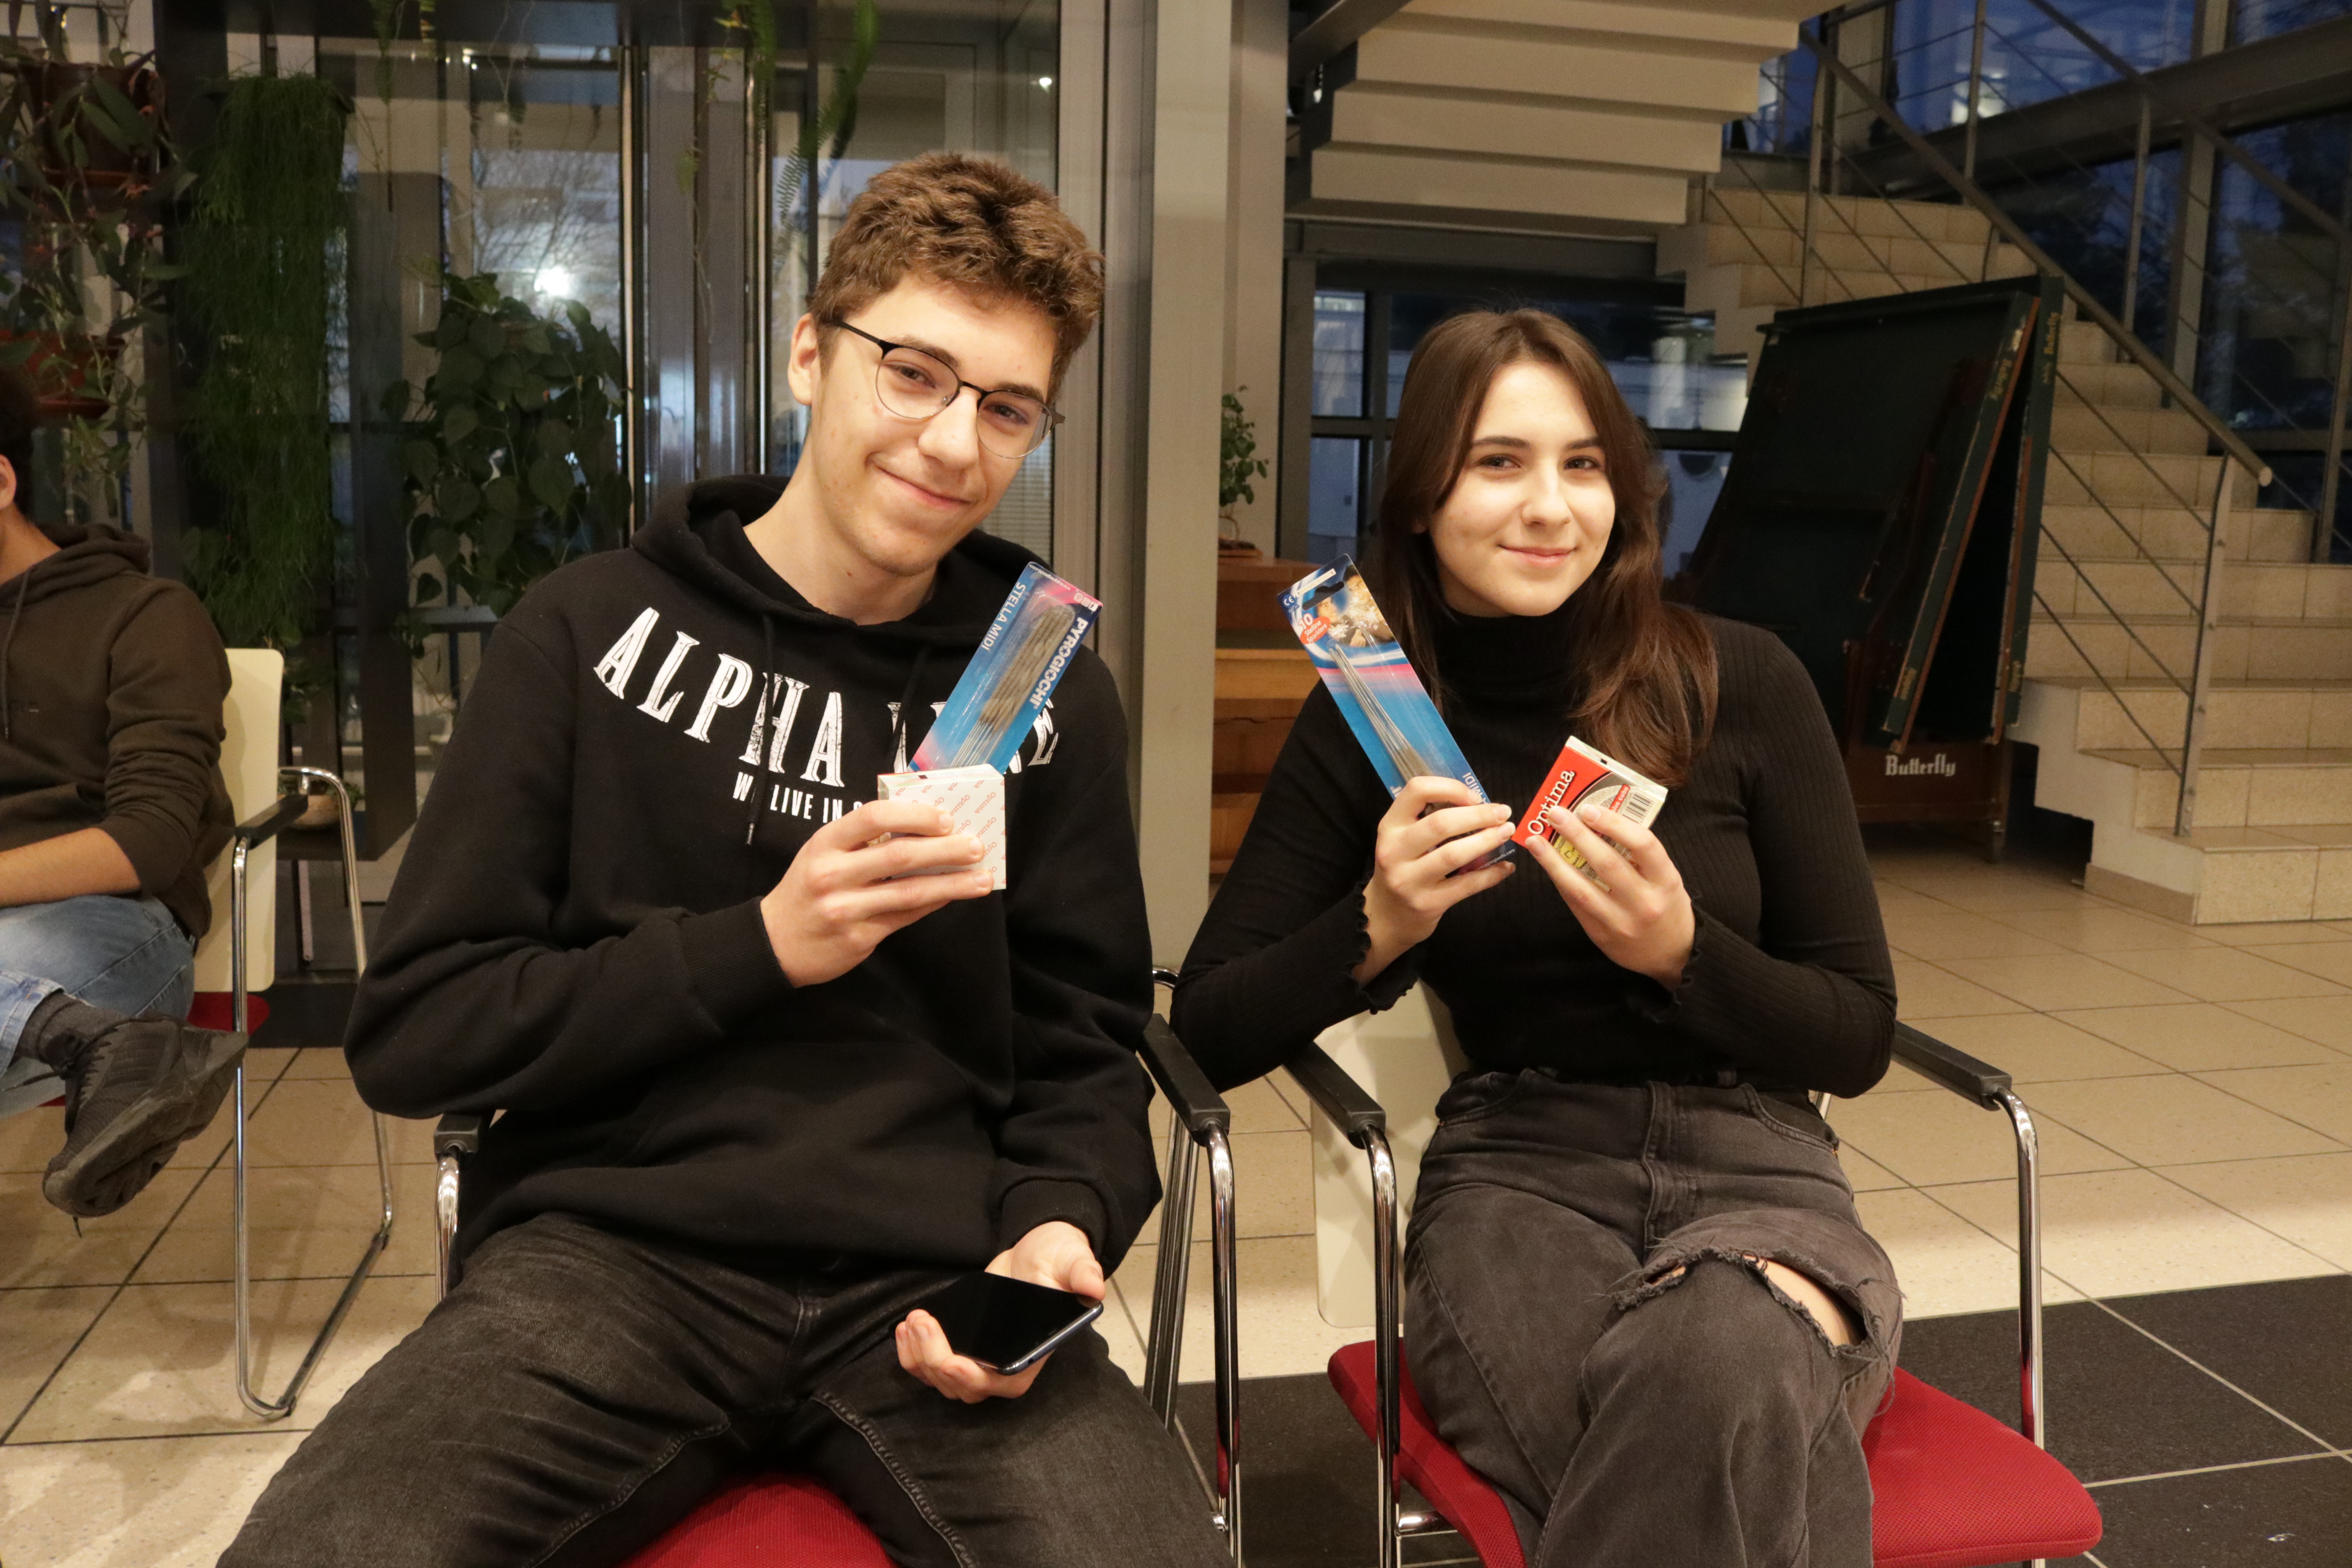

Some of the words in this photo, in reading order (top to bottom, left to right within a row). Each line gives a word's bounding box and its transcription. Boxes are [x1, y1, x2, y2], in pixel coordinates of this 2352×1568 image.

[996, 582, 1026, 622] STELLA
[1298, 613, 1313, 630] 10
[1304, 621, 1321, 637] Stelline
[981, 623, 1003, 651] MIDI
[1307, 624, 1328, 643] Sparklers
[1029, 617, 1089, 706] PYROGIOCHI
[593, 607, 845, 787] ALPHA
[1885, 753, 1956, 777] Butterfly
[733, 771, 757, 804] W
[770, 784, 814, 820] LIVE
[822, 797, 843, 824] IN
[975, 792, 996, 813] Optima
[1527, 770, 1575, 835] Optima
[1618, 786, 1629, 801] cube
[950, 795, 970, 816] Optima
[955, 820, 971, 835] Opti
[976, 817, 996, 838] Optima
